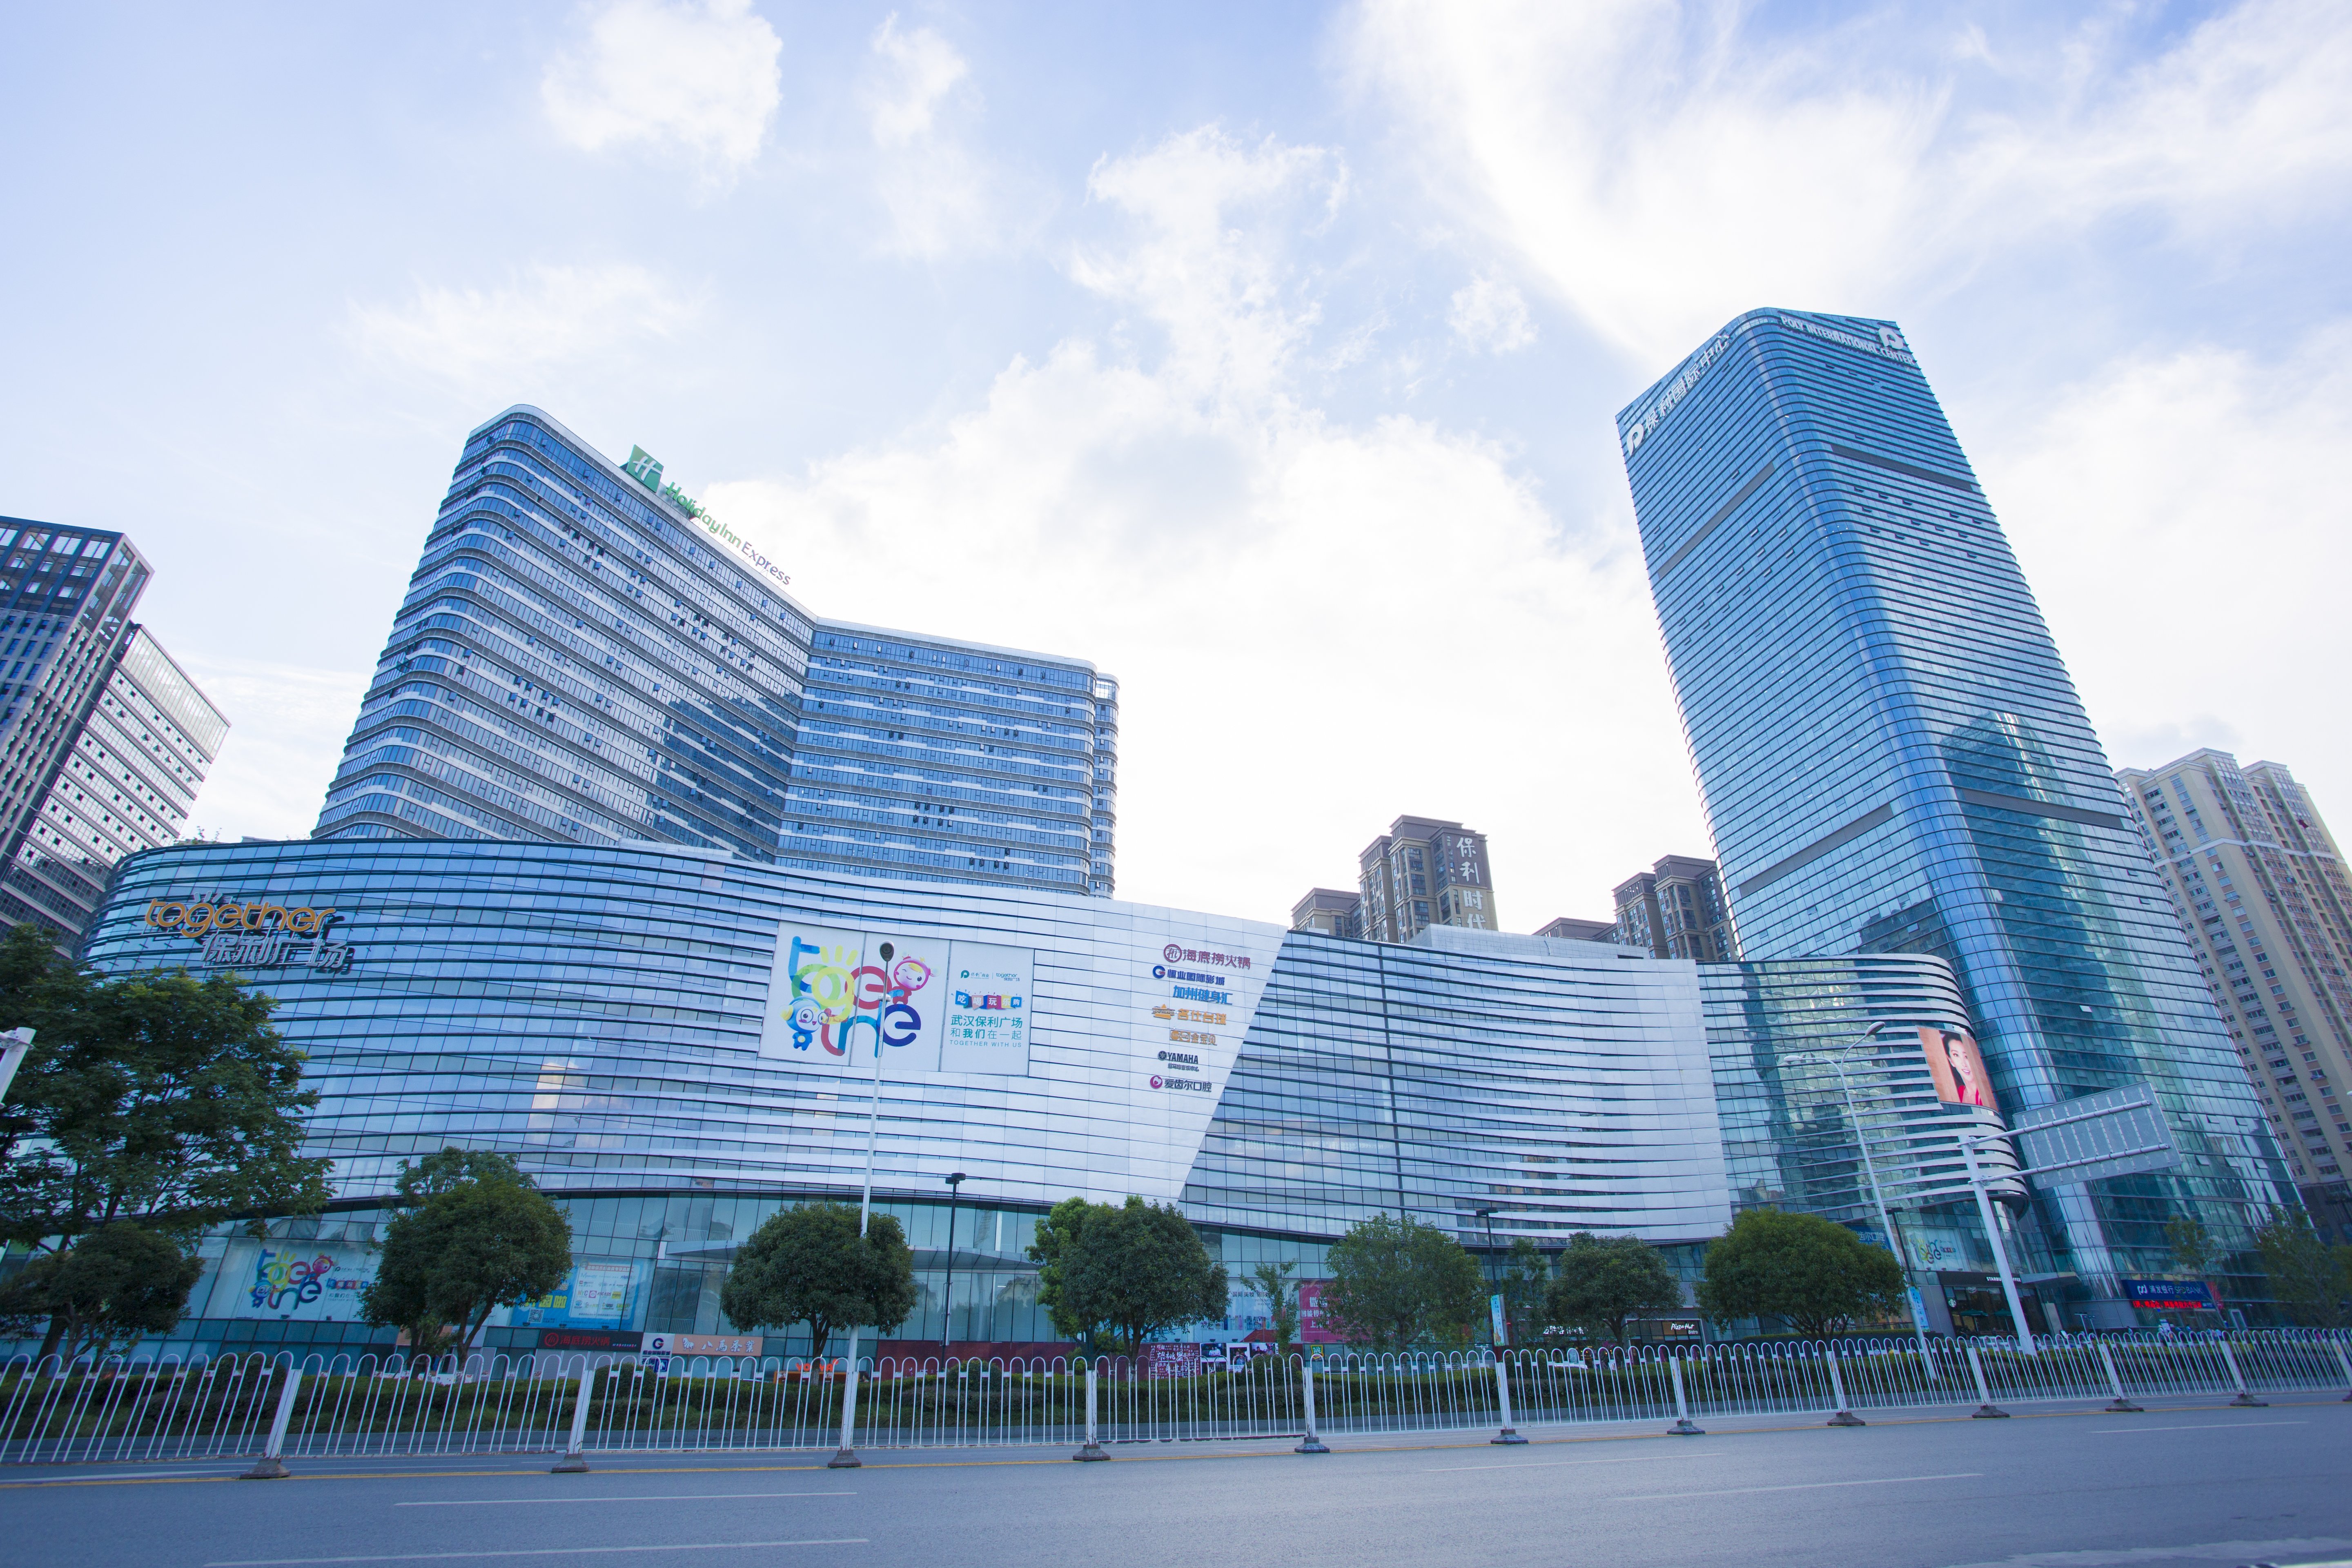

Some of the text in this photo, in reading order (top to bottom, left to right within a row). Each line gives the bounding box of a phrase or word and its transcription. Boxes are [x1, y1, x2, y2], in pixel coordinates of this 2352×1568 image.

[1780, 316, 1916, 366] POLY INTERNATIONAL CENTER
[1645, 333, 1730, 432] 保利国际中心
[666, 481, 791, 586] Holiday Inn Express
[1456, 837, 1487, 929] 保利时代
[144, 897, 337, 938] together
[199, 933, 347, 969] 保利广场
[1183, 949, 1251, 970] 海底捞火锅
[1167, 969, 1225, 986] 恒业国际影城
[1173, 985, 1233, 1005] 加州健身汇
[950, 1014, 1023, 1029] 武汉保利广场
[1177, 1008, 1227, 1025] 名仕台球
[950, 1027, 1022, 1040] 和我们在一起
[1191, 1032, 1218, 1046] 金宝贝
[1167, 1052, 1199, 1065] YAMAHA
[1164, 1078, 1212, 1093] 爱齿尔口腔
[1857, 1231, 1885, 1241] 齿尔口腔
[2149, 1285, 2174, 1294] 浦发银行
[560, 1335, 610, 1346] 海底捞火锅
[701, 1339, 755, 1352] 八馬茶業
